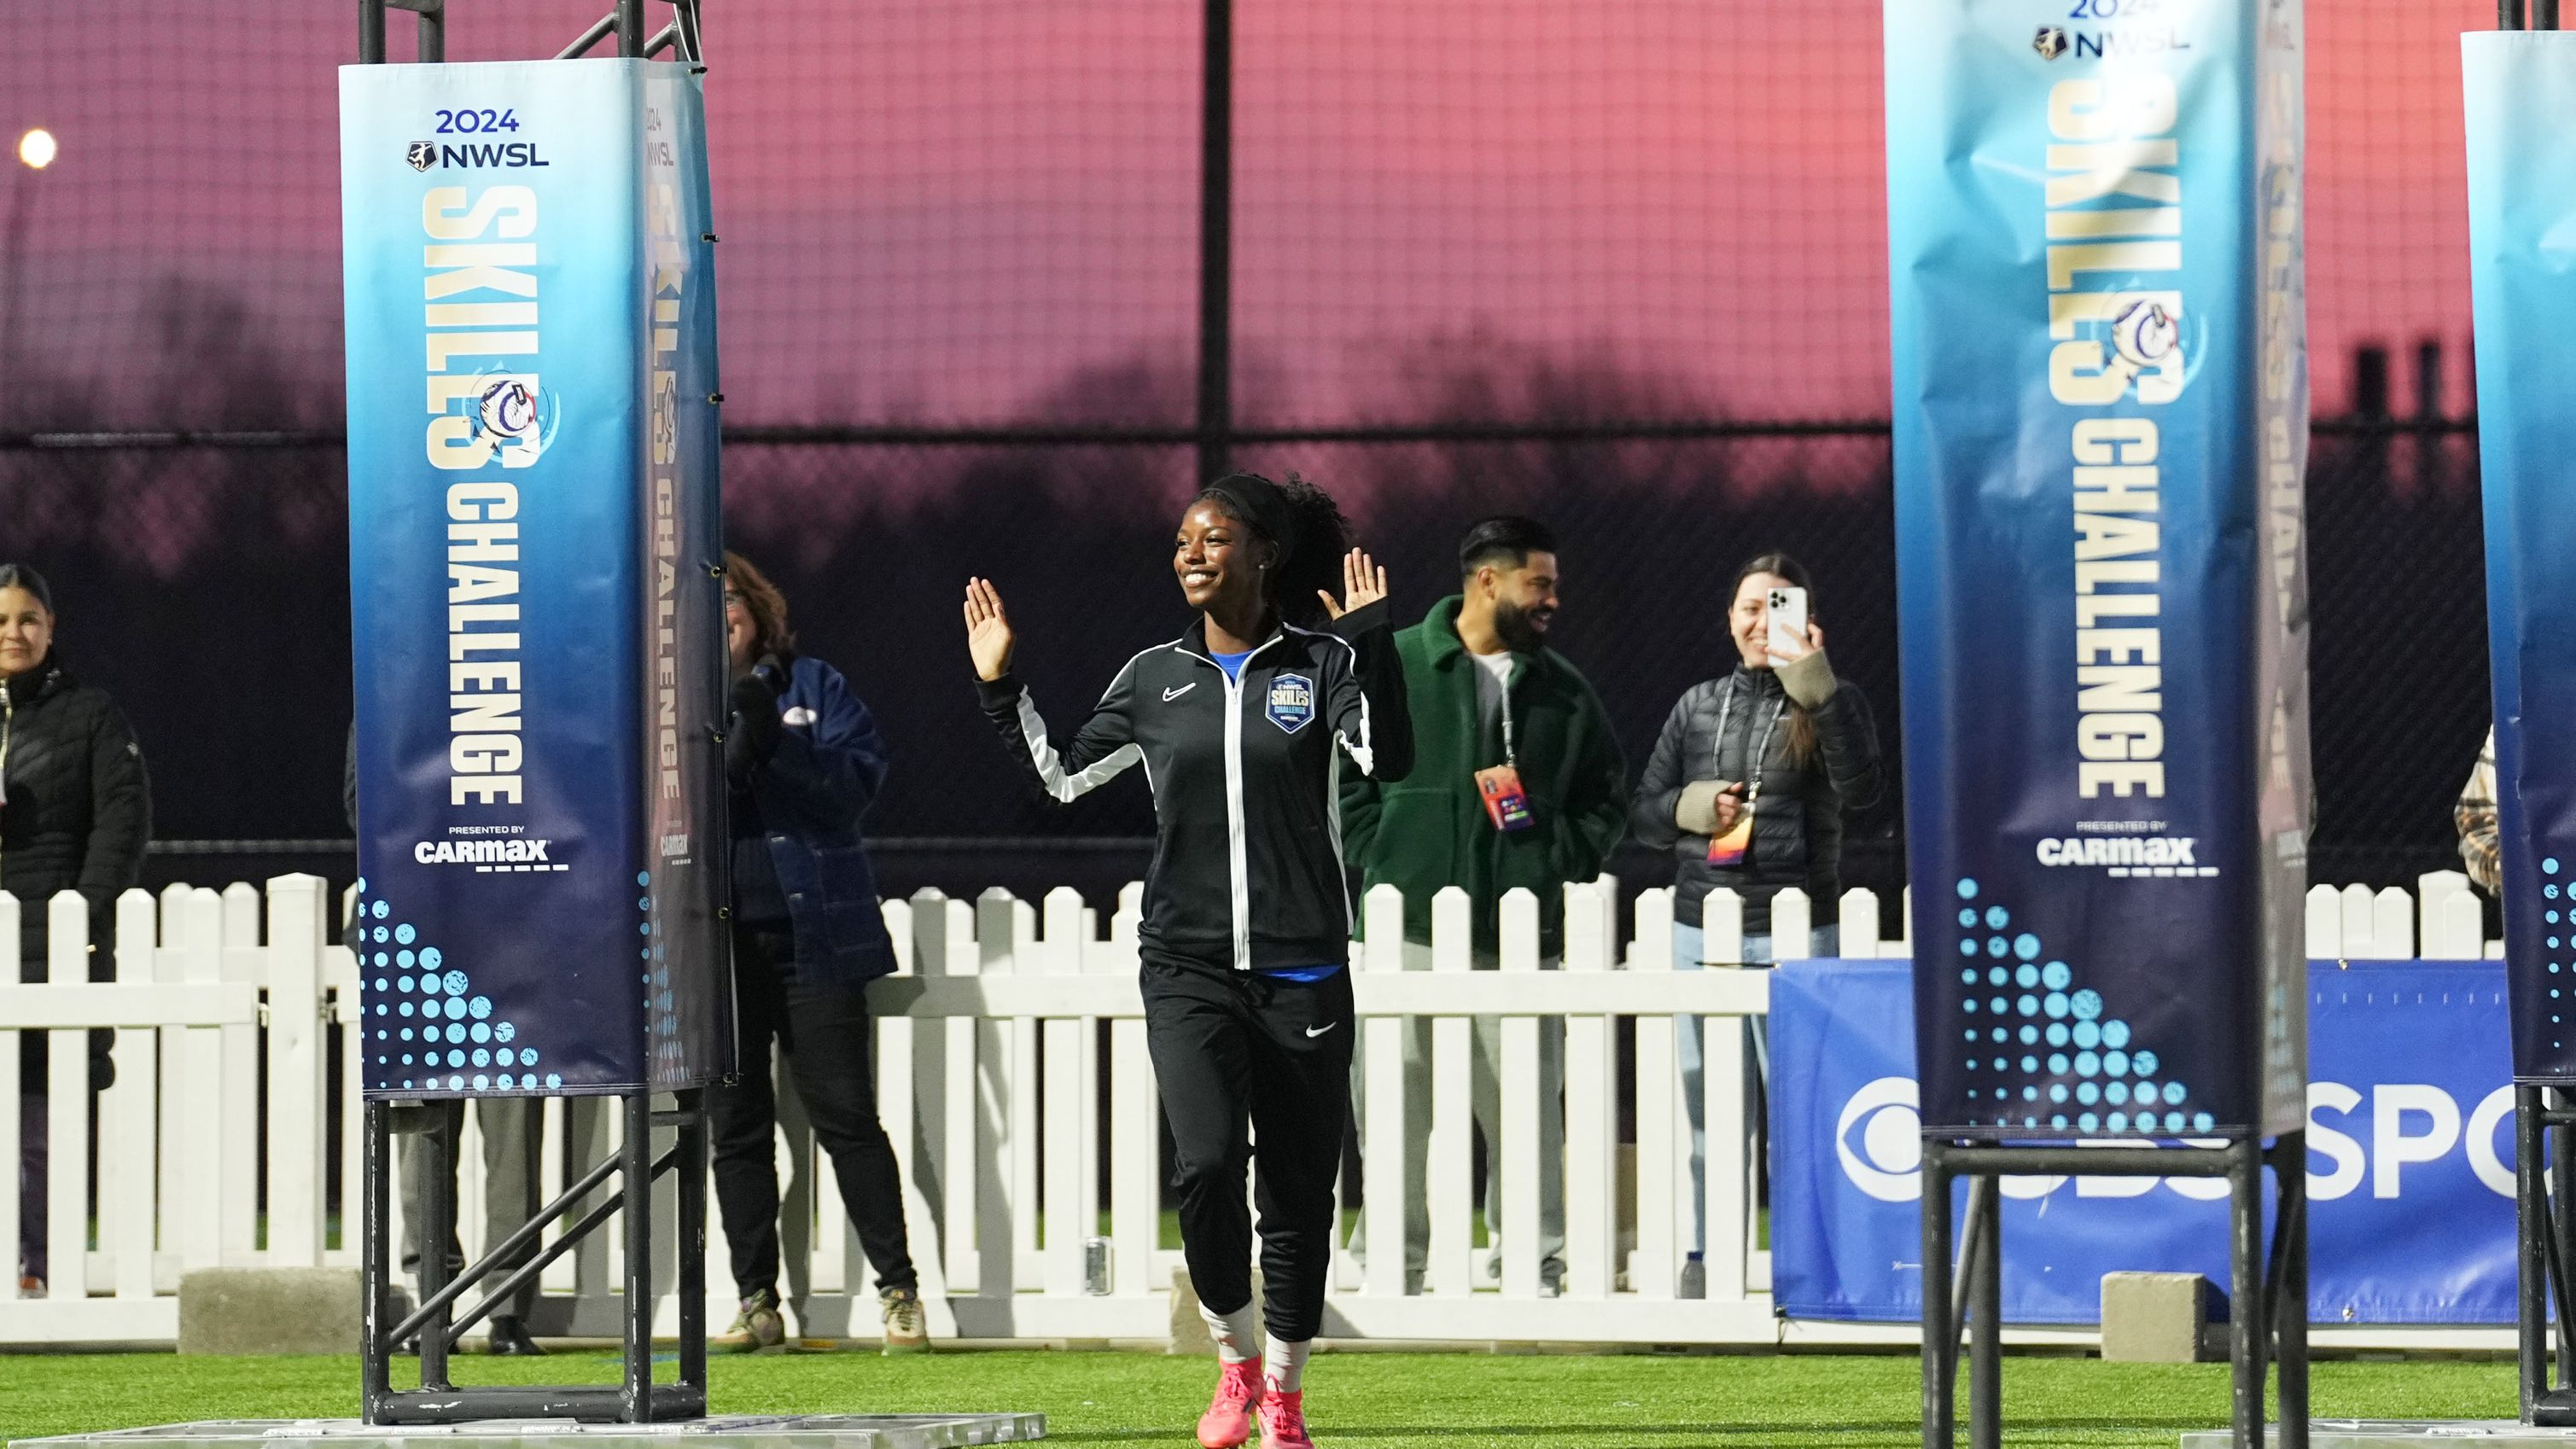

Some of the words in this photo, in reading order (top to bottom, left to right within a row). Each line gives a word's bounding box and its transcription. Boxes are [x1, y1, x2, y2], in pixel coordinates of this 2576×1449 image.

[2075, 26, 2191, 58] NWSL
[435, 108, 520, 134] 2024
[442, 143, 549, 168] NWSL
[2045, 77, 2184, 404] SKILLS
[423, 185, 540, 468] SKILLS
[2072, 418, 2165, 798] CHALLENGE
[446, 482, 522, 805] CHALLENGE
[656, 478, 680, 799] CHALLENGE
[1271, 690, 1308, 706] SKILLS
[449, 826, 509, 835] PRESENTED
[511, 825, 524, 834] BY
[2076, 821, 2147, 833] PRESENTED
[2150, 821, 2168, 832] BY
